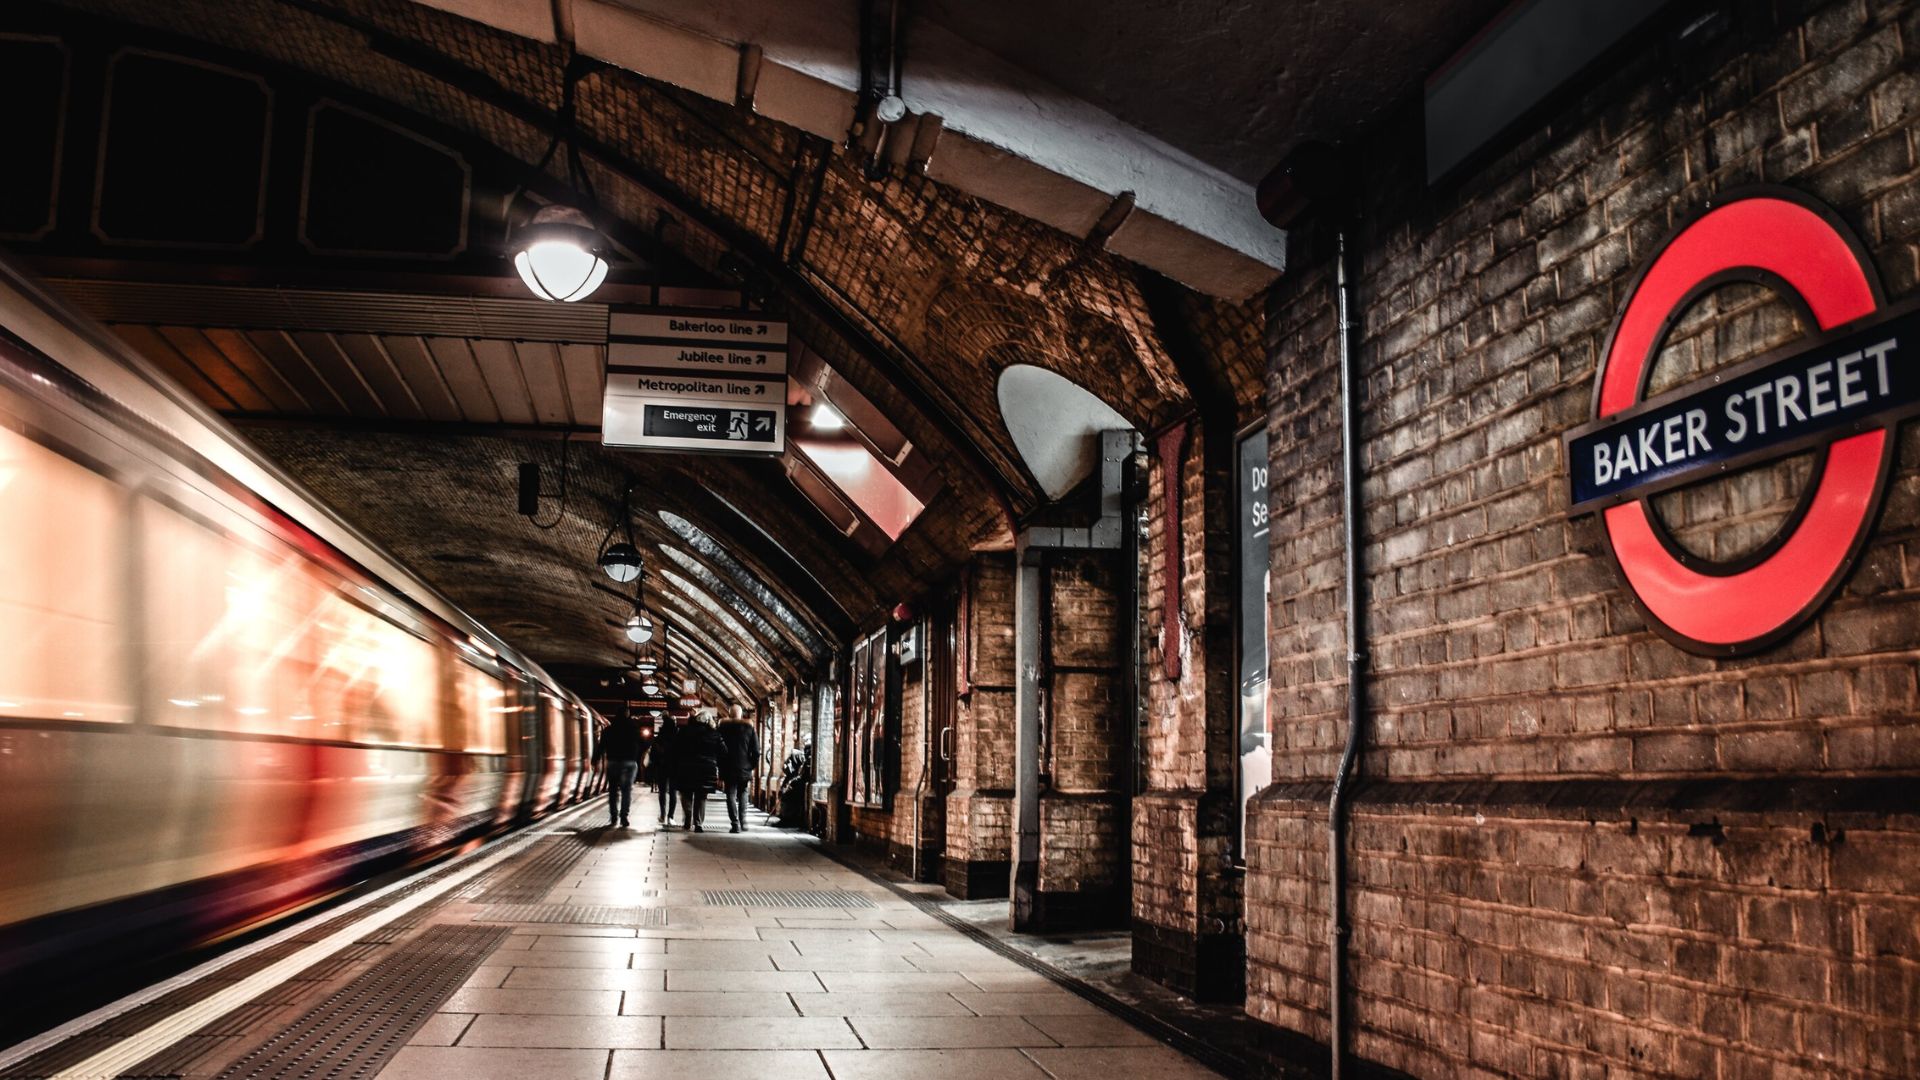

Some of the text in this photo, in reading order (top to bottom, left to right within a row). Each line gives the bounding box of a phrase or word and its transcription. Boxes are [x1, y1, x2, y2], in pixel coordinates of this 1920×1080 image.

[669, 319, 753, 335] Bakerloo line
[677, 350, 752, 365] Jubilee line
[638, 378, 750, 395] Metropolitan line
[663, 410, 717, 423] Emergency
[1593, 337, 1898, 486] BAKER STREET
[696, 423, 716, 432] exit
[1252, 466, 1269, 492] Do
